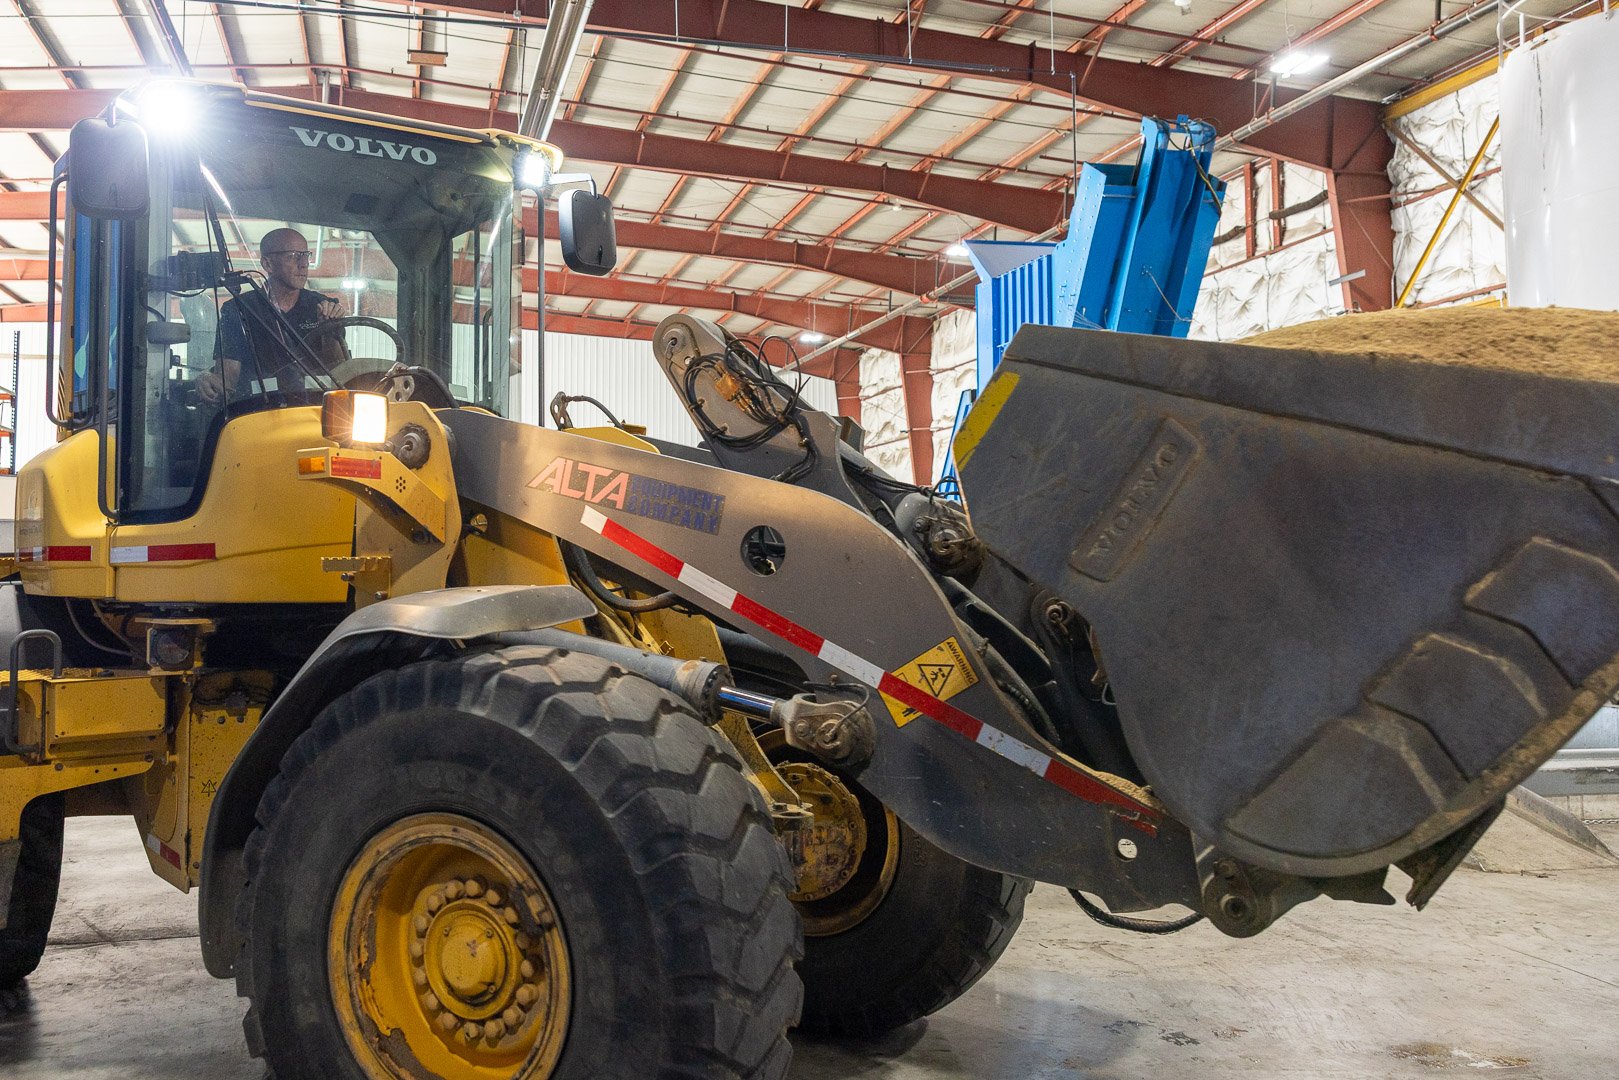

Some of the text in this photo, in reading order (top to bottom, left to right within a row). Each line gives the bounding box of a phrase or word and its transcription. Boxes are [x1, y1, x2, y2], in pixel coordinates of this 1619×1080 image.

[288, 126, 437, 165] VOLVO
[527, 456, 630, 510] ALTA
[630, 475, 724, 513] EQUIPMENT
[1086, 443, 1178, 558] VOLVO
[626, 495, 719, 533] COMPANY
[949, 646, 976, 684] WARNING
